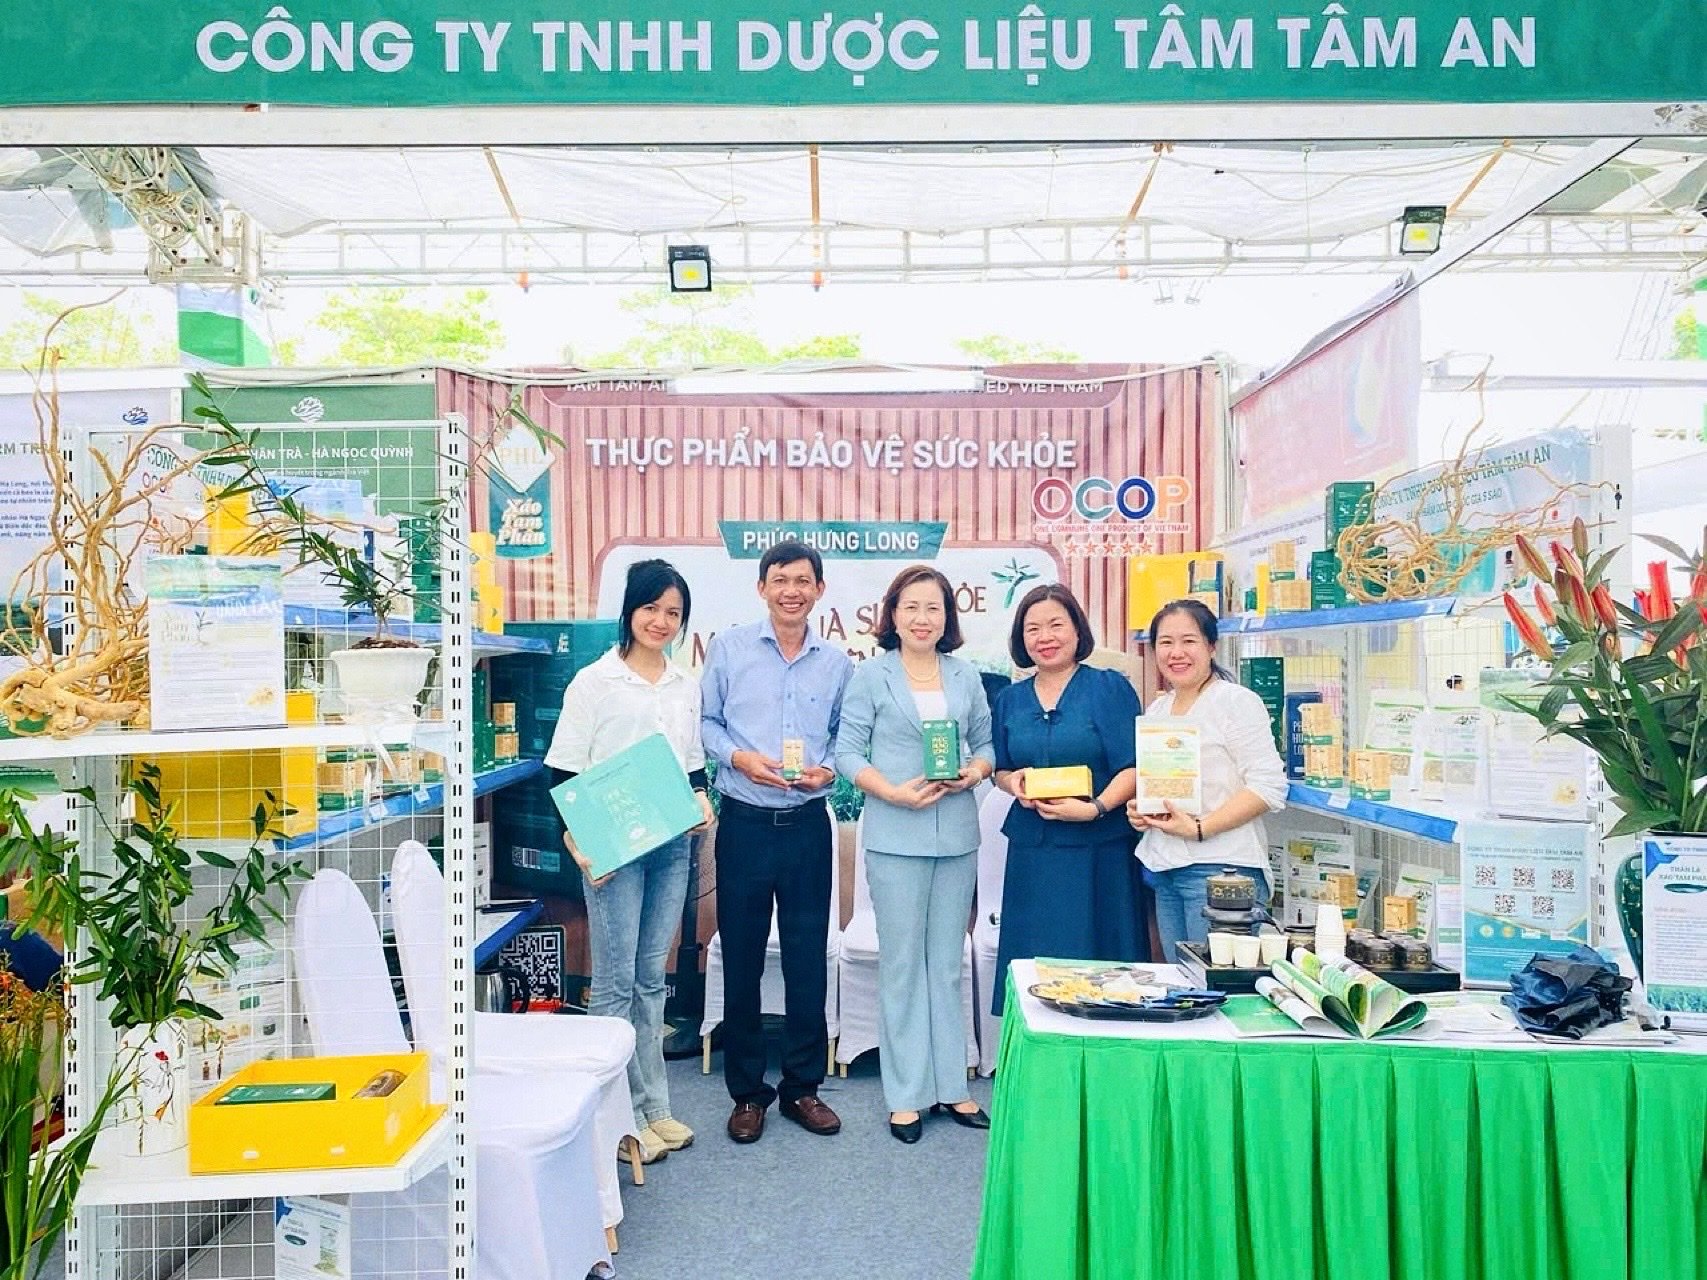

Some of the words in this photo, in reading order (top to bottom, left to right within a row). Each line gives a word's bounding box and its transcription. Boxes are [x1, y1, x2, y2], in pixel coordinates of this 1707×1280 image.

[196, 6, 414, 73] CÔNG
[435, 20, 511, 72] TY
[532, 20, 713, 71] TNHH
[739, 12, 940, 86] DƯỢC
[965, 4, 1092, 86] LIỆU
[1114, 3, 1254, 70] TÂM
[1278, 2, 1415, 69] TÂM
[1440, 16, 1536, 68] AN
[332, 447, 367, 461] NGỌC
[586, 435, 673, 473] THỰC
[683, 426, 777, 467] PHẨM
[787, 431, 853, 468] BẢO
[862, 432, 905, 476] VỆ
[913, 433, 979, 469] SỨC
[988, 431, 1077, 468] KHỎE
[1533, 443, 1552, 465] AN
[1033, 475, 1191, 521] OCOP
[804, 530, 859, 551] HƯNG
[864, 531, 920, 551] LONG
